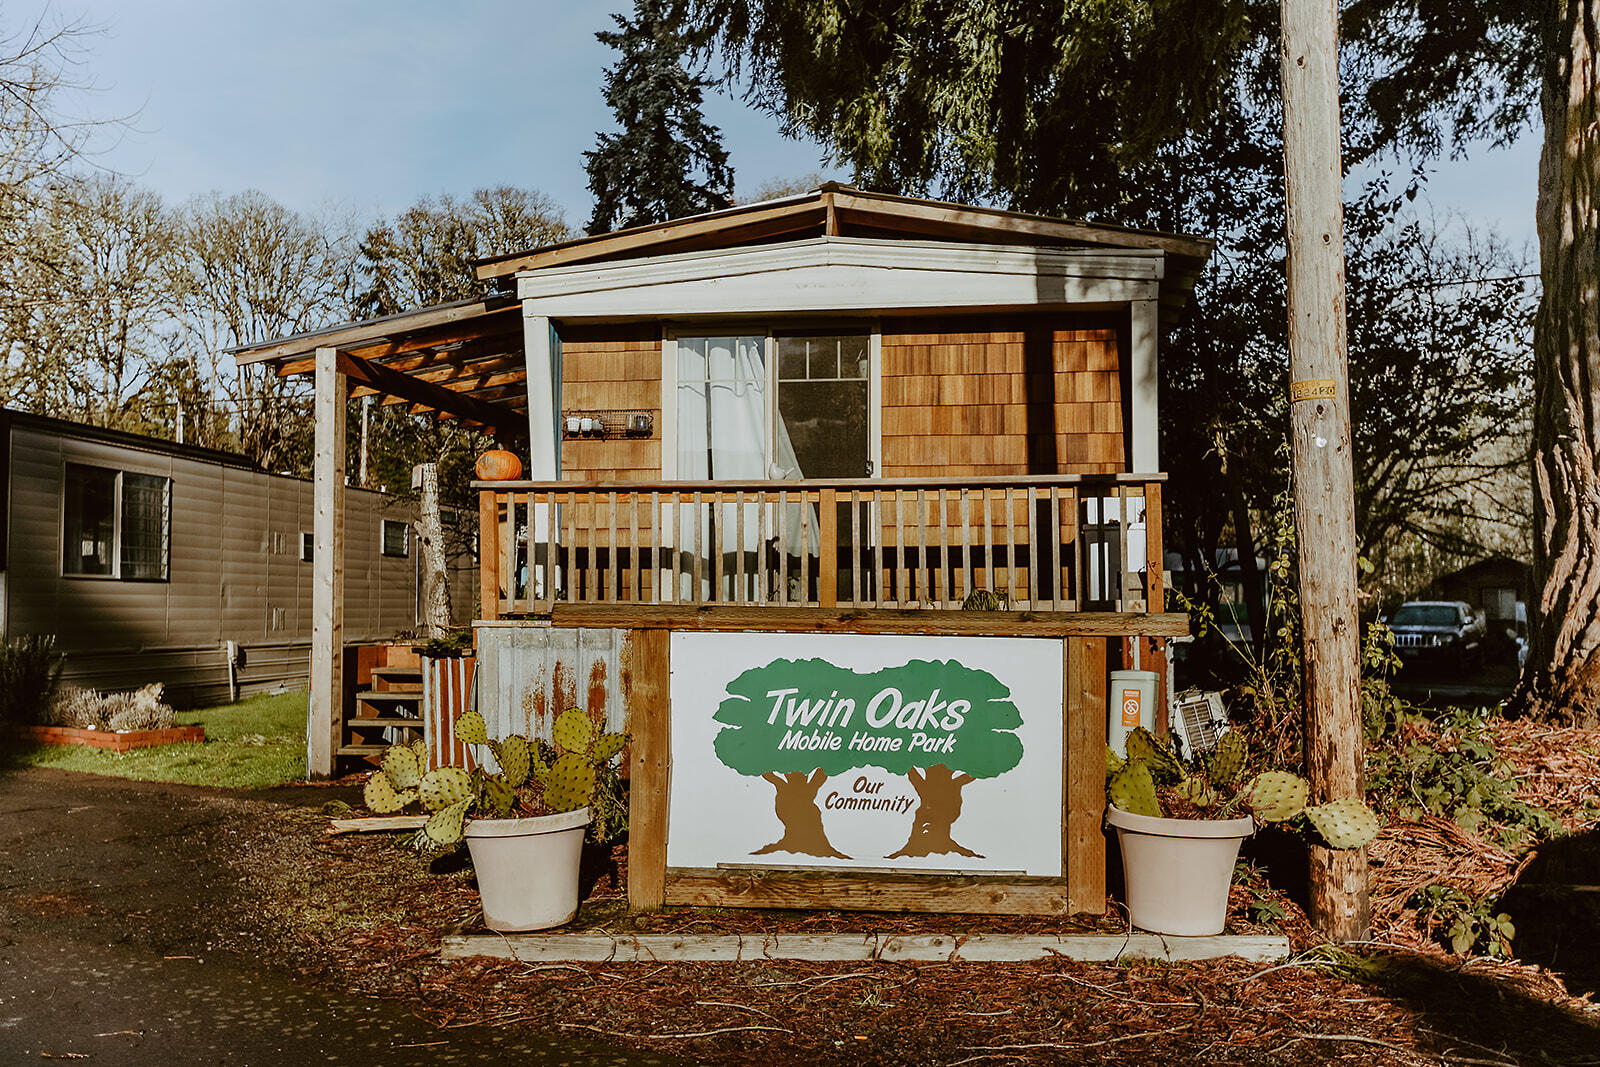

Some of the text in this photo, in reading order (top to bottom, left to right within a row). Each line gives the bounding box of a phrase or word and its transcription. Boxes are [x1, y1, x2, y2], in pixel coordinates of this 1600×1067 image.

[766, 687, 972, 731] Twin Oaks
[778, 730, 957, 754] Mobile Home Park
[853, 776, 885, 795] Our
[825, 791, 915, 816] Community
